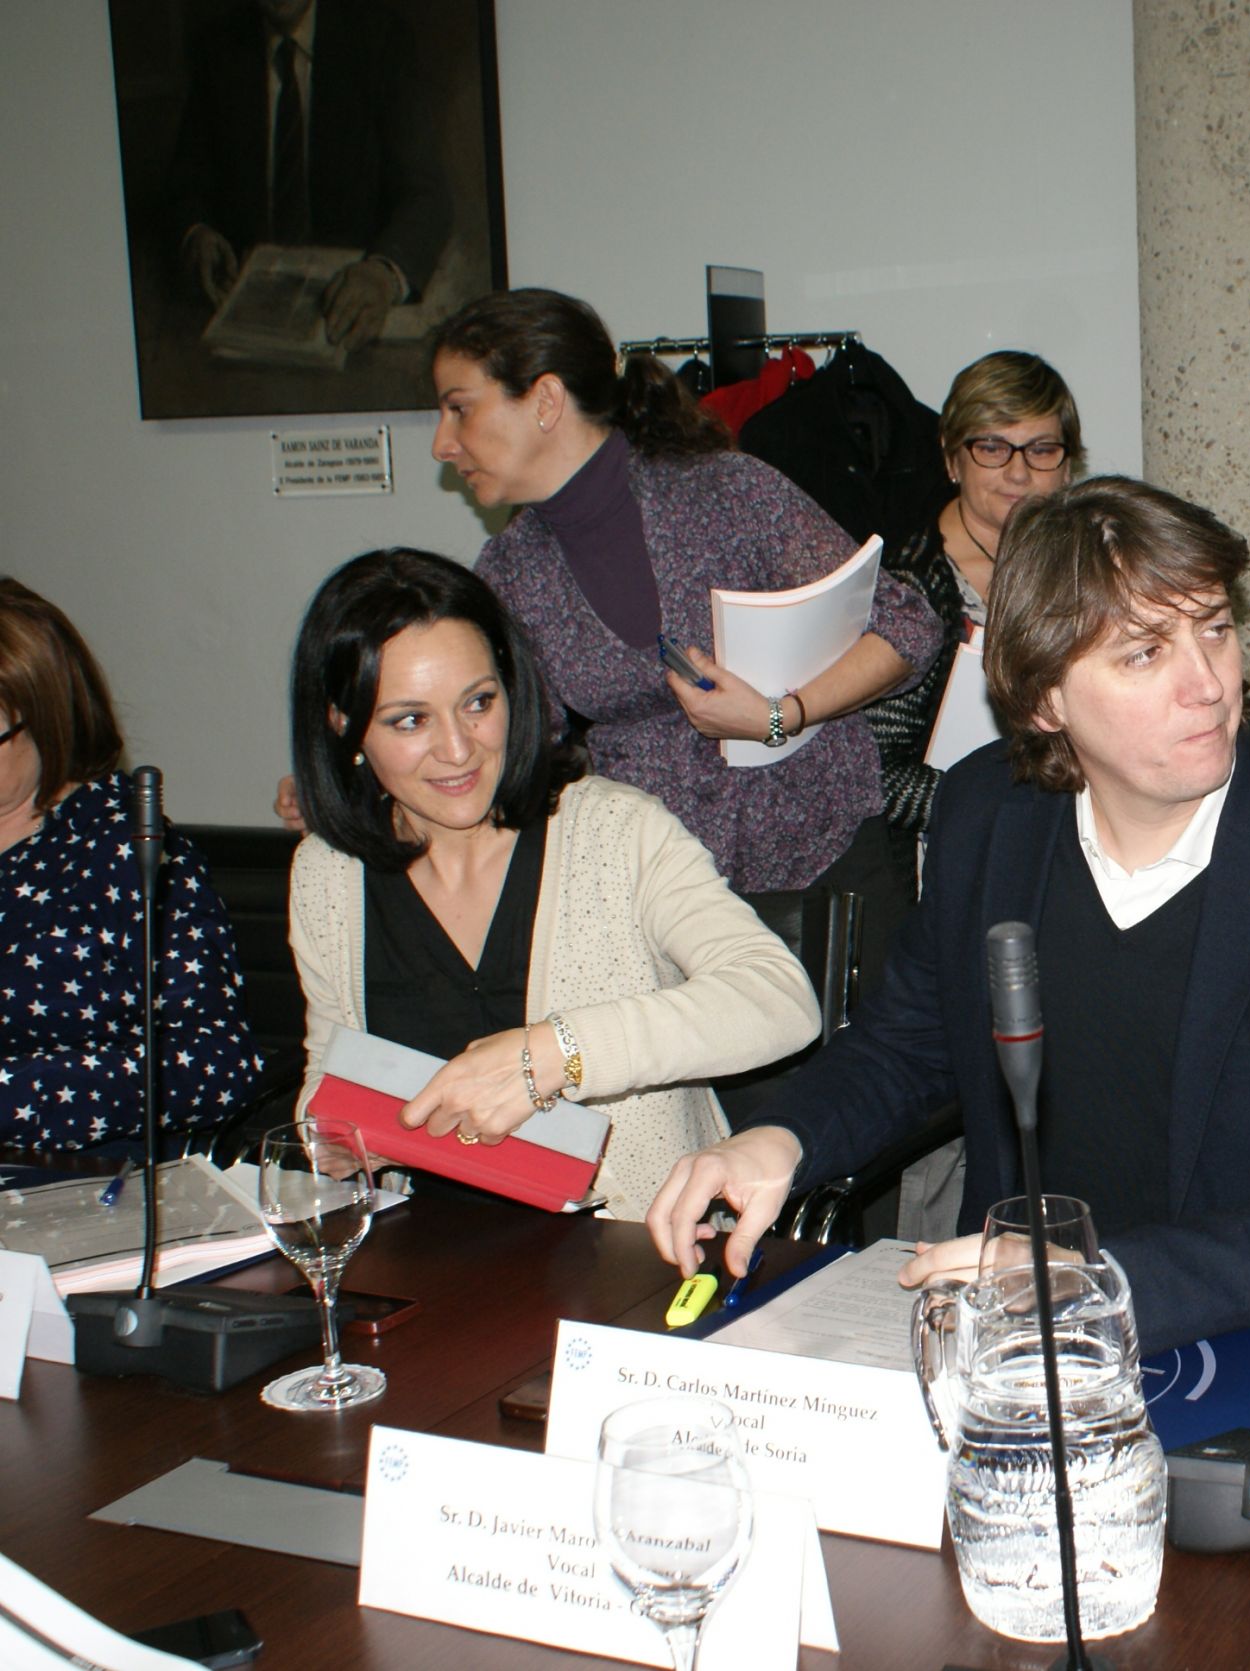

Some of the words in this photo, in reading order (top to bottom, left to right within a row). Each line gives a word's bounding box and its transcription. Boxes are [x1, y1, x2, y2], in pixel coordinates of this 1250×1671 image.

[617, 1366, 638, 1385] Sr.
[643, 1371, 662, 1389] D.
[666, 1374, 718, 1397] Carlos
[765, 1442, 807, 1463] Soria
[440, 1504, 462, 1525] Sr.
[468, 1510, 487, 1529] D.
[491, 1515, 544, 1539] Javier
[549, 1526, 597, 1548] Maro
[625, 1529, 711, 1552] Aranzabal
[548, 1554, 596, 1578] Vocal
[447, 1564, 512, 1592] Alcalde
[517, 1577, 539, 1596] de
[550, 1584, 611, 1611] Vitoria
